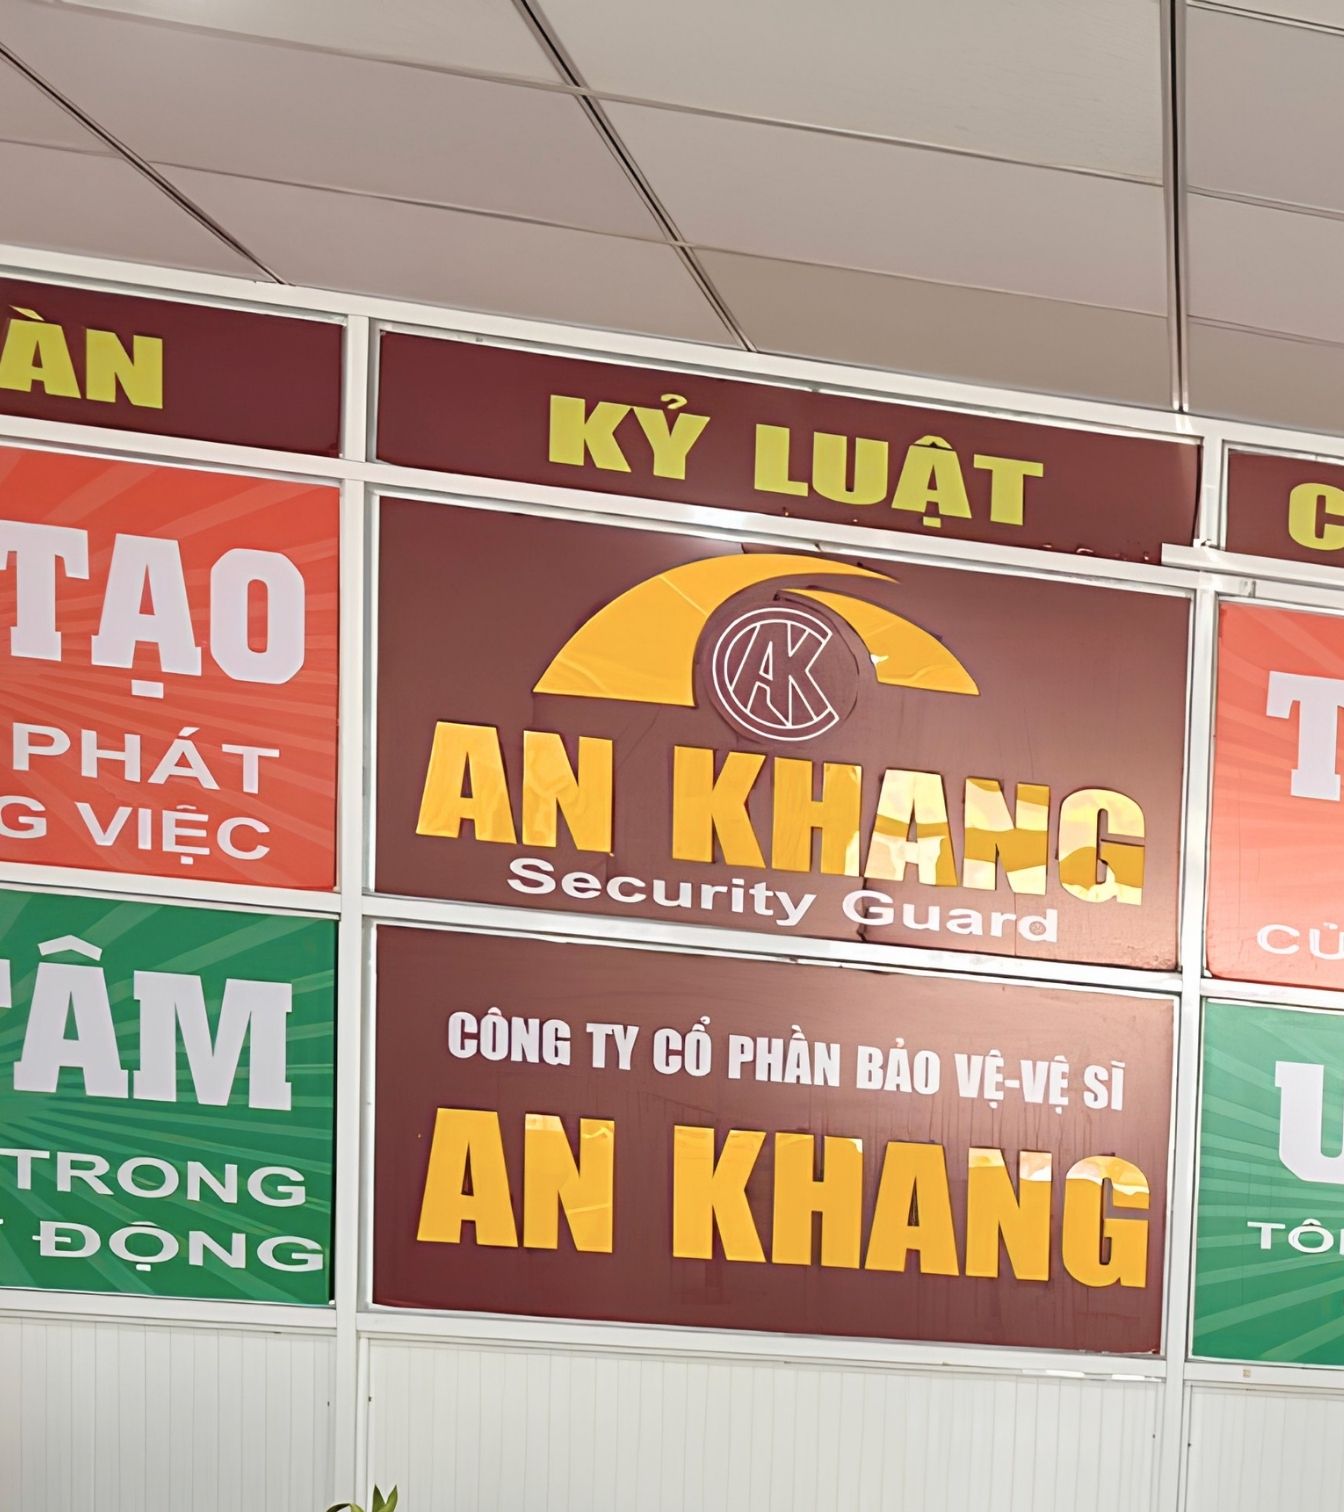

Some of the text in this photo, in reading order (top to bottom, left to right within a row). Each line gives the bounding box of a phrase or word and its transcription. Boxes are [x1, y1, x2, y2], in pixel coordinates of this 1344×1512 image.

[548, 393, 1044, 527] KỶ LUẬT
[0, 519, 304, 698] TẠO
[12, 726, 280, 794] PHÁT
[74, 802, 271, 864] VIỆC
[415, 721, 1147, 905] AN KHANG
[507, 857, 1058, 943] Security Guard
[0, 935, 292, 1111] ÂM
[448, 1006, 570, 1067] CÔNG
[586, 1023, 638, 1072] TY
[654, 1016, 712, 1077] CỔ
[728, 1025, 841, 1087] PHẦN
[857, 1037, 940, 1096] BẢO
[1084, 1060, 1126, 1111] SĨ
[0, 1148, 306, 1207] TRONG
[416, 1107, 1151, 1289] AN KHANG
[32, 1220, 324, 1271] ĐỘNG
